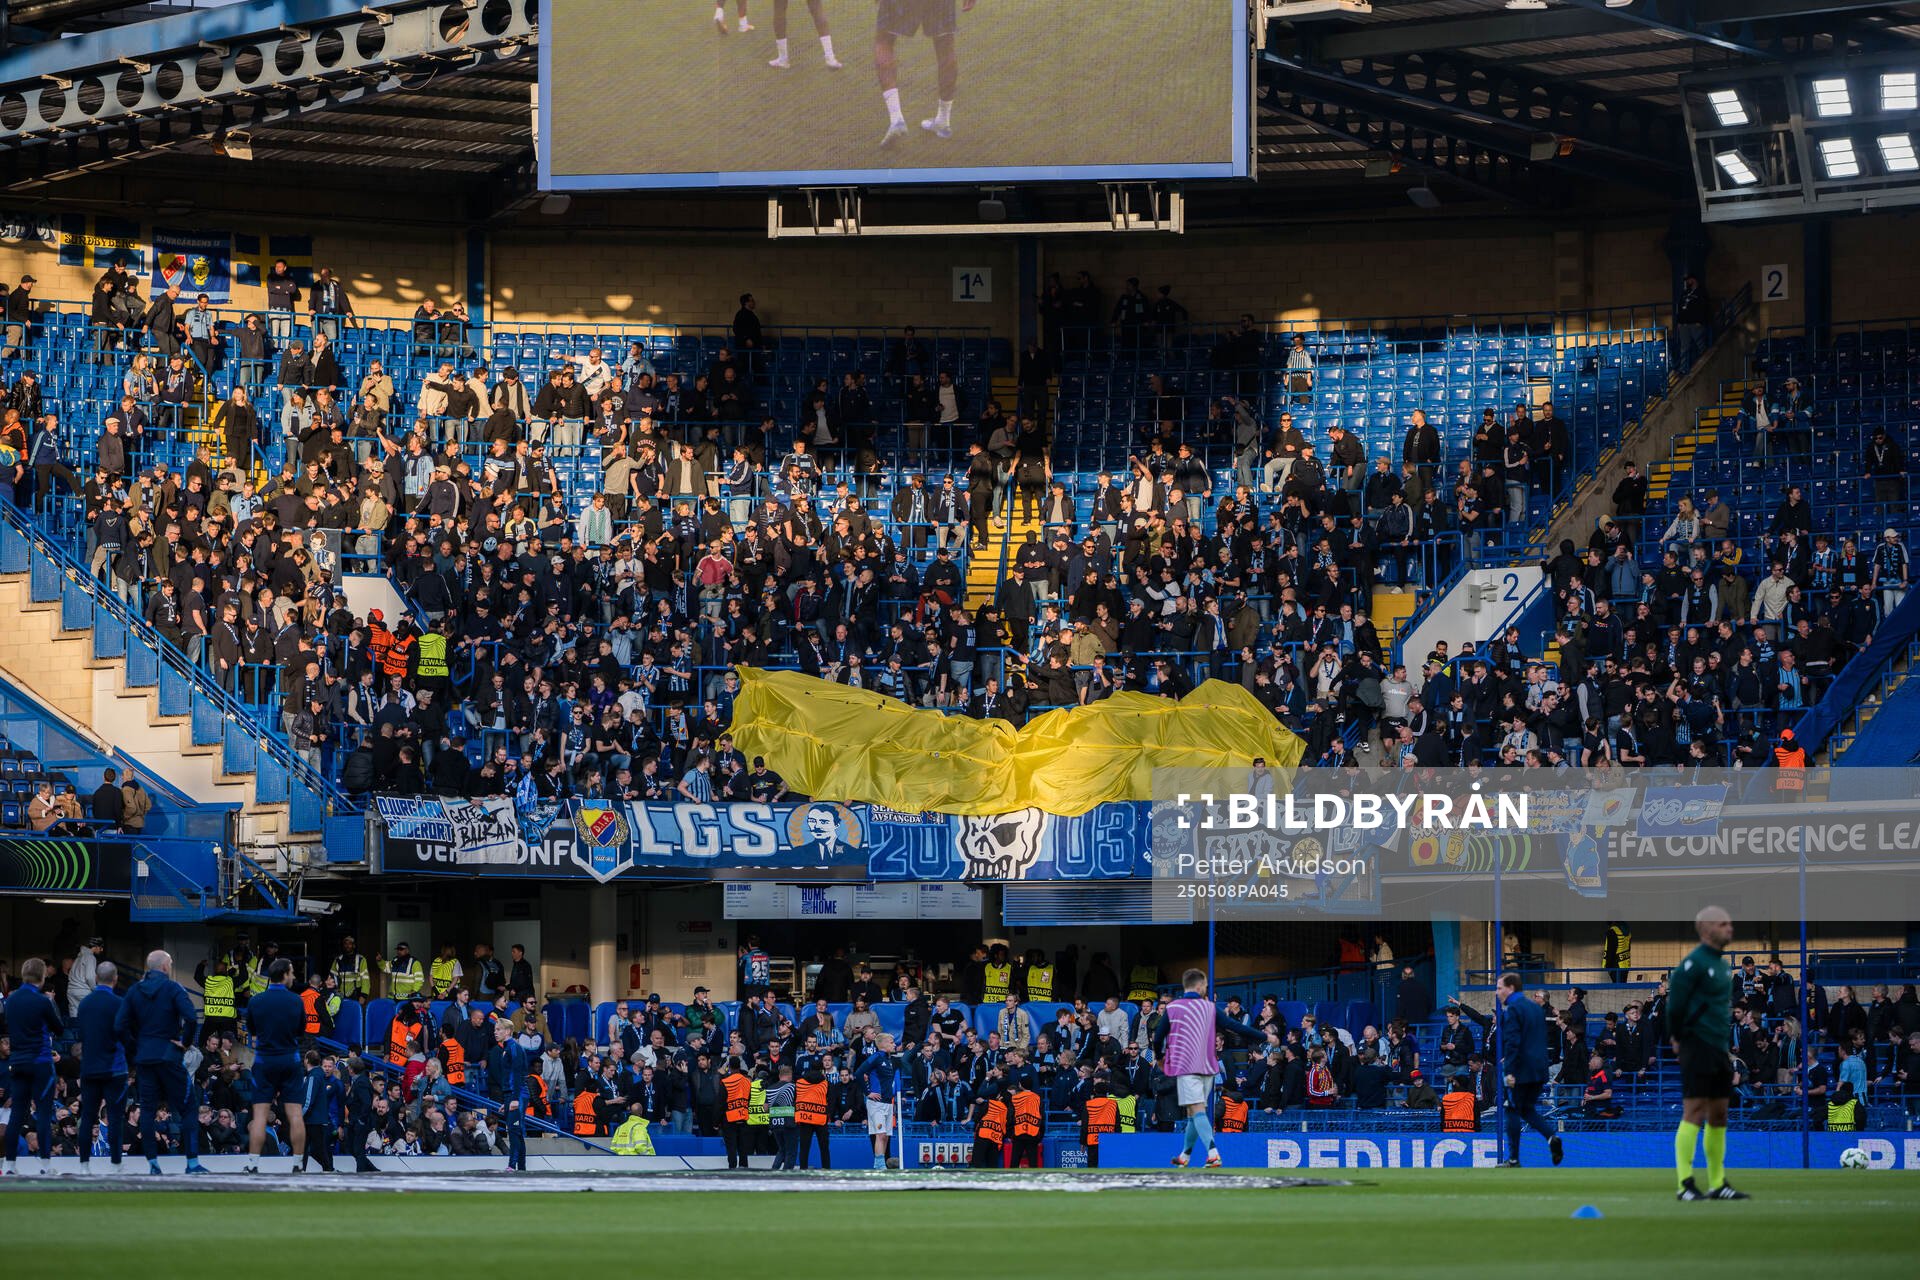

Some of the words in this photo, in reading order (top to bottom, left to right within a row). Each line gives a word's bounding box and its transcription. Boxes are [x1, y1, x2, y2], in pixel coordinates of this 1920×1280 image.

[1767, 270, 1783, 298] 2
[1503, 573, 1519, 601] 2
[813, 900, 837, 914] HOME
[752, 961, 769, 977] 25
[1445, 1120, 1475, 1128] TEWARD
